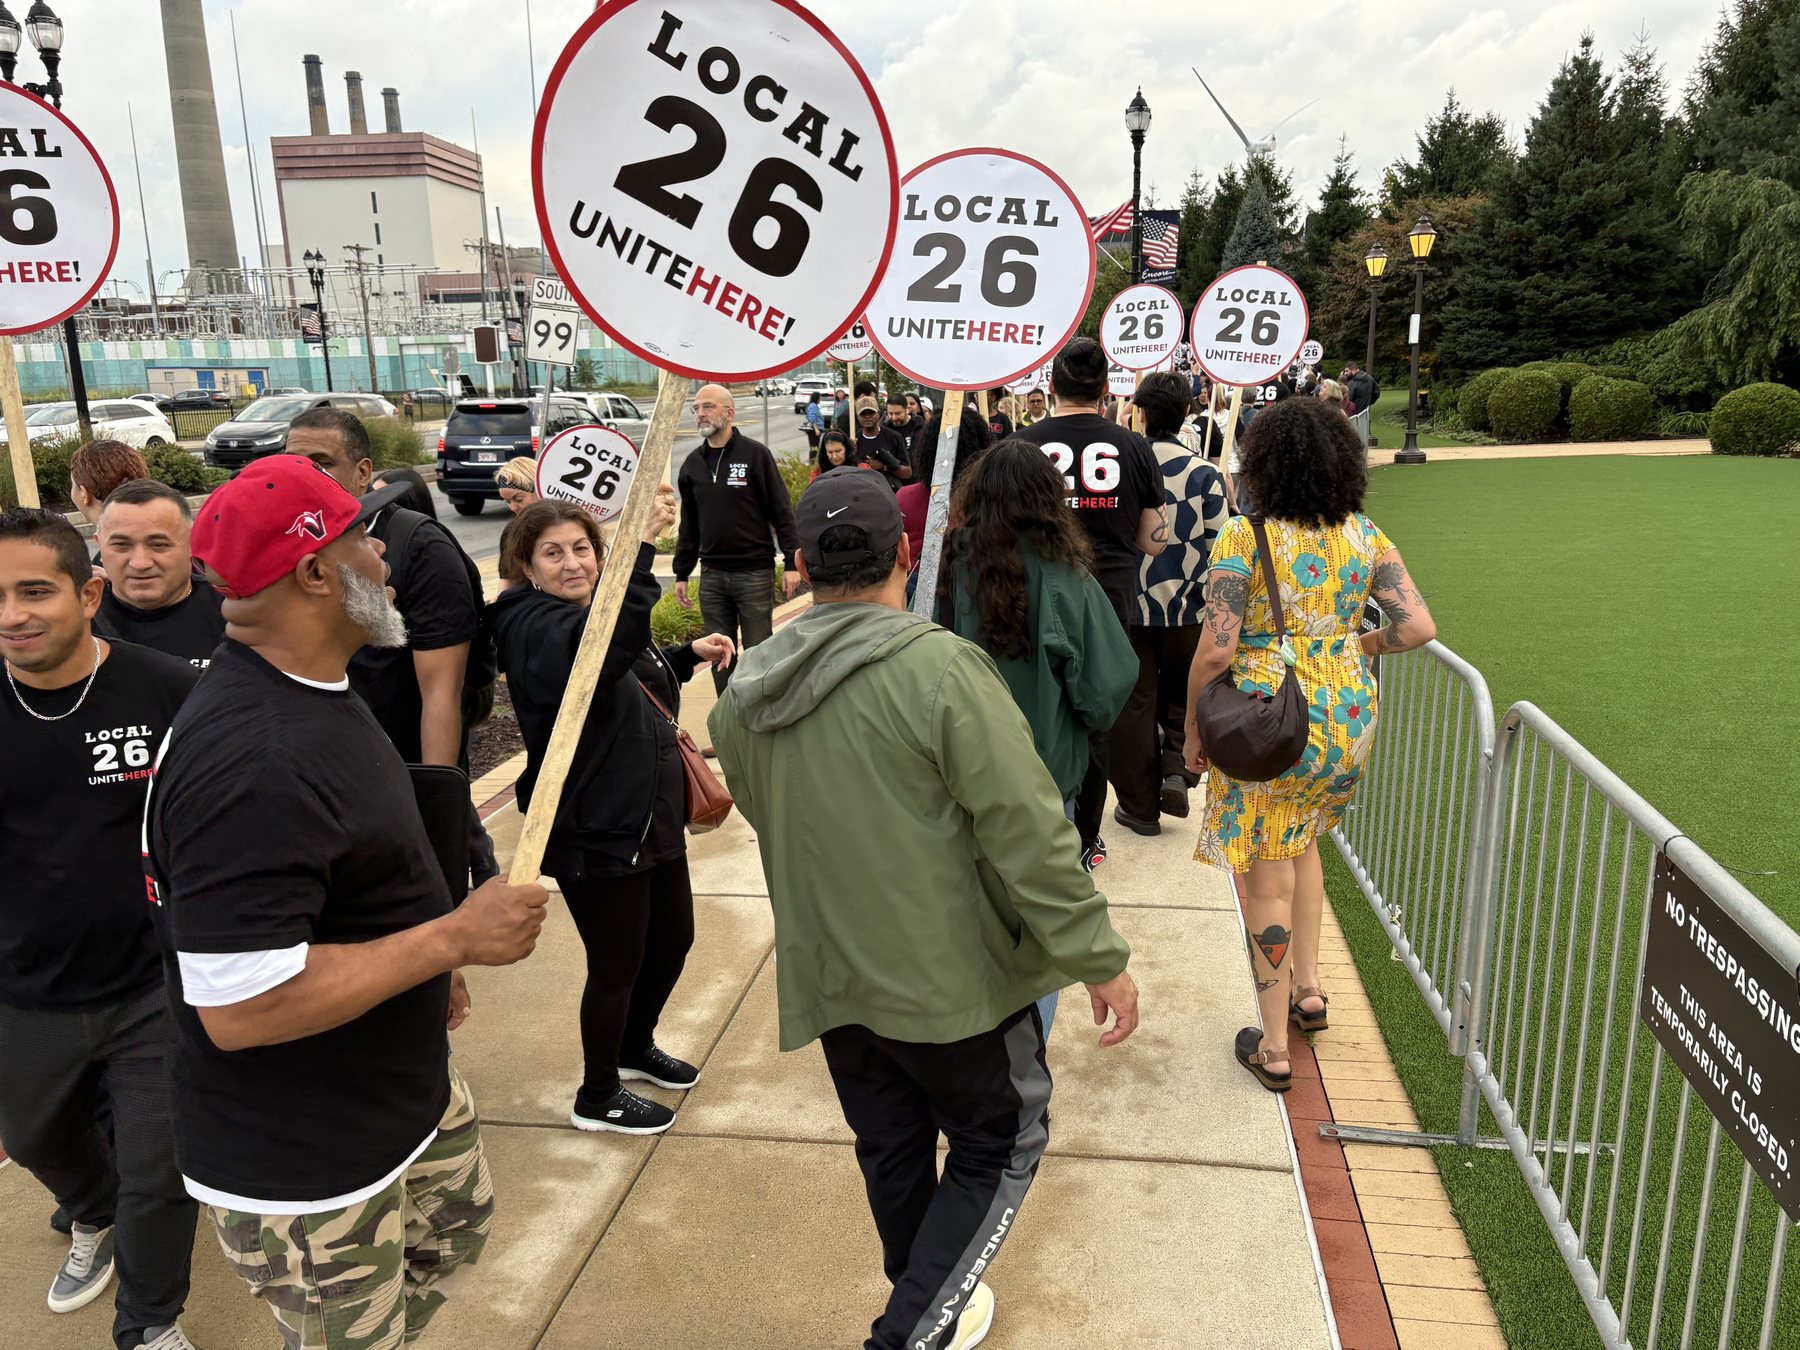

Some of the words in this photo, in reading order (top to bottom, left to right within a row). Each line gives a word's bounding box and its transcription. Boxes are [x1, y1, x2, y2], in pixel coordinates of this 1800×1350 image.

[647, 10, 864, 183] LOCAL
[612, 95, 824, 278] 26
[0, 169, 58, 245] 6
[904, 194, 1058, 227] LOCAL
[0, 260, 81, 282] HERE!
[569, 199, 796, 347] UNITEHERE!
[906, 232, 1039, 308] 26
[1141, 268, 1176, 279] Encore
[1115, 299, 1169, 313] LOCAL
[1216, 287, 1291, 306] LOCAL
[534, 319, 572, 351] 99
[887, 316, 1044, 346] UNITEHERE!
[1119, 313, 1164, 342] 26
[1215, 307, 1281, 346] 26
[1205, 349, 1281, 366] UNITEHERE!
[1304, 348, 1318, 357] 26
[1108, 376, 1135, 384] NITEHE
[1256, 385, 1278, 401] 26
[569, 435, 633, 473] LOCAL
[1039, 442, 1120, 493] 26
[559, 456, 621, 501] 26
[730, 468, 746, 477] 26
[1064, 496, 1119, 508] TEHERE!
[84, 725, 153, 743] LOCAL
[92, 739, 150, 771] 26
[1665, 891, 1686, 928] NO
[1689, 914, 1800, 1054] TRESPASSING
[1651, 985, 1729, 1096] TEMPORARILY
[1680, 984, 1706, 1029] THIS
[1708, 1021, 1743, 1076] AREA
[1748, 1065, 1763, 1096] IS
[960, 1207, 1014, 1292] UNDER
[915, 1293, 960, 1350] ARMO
